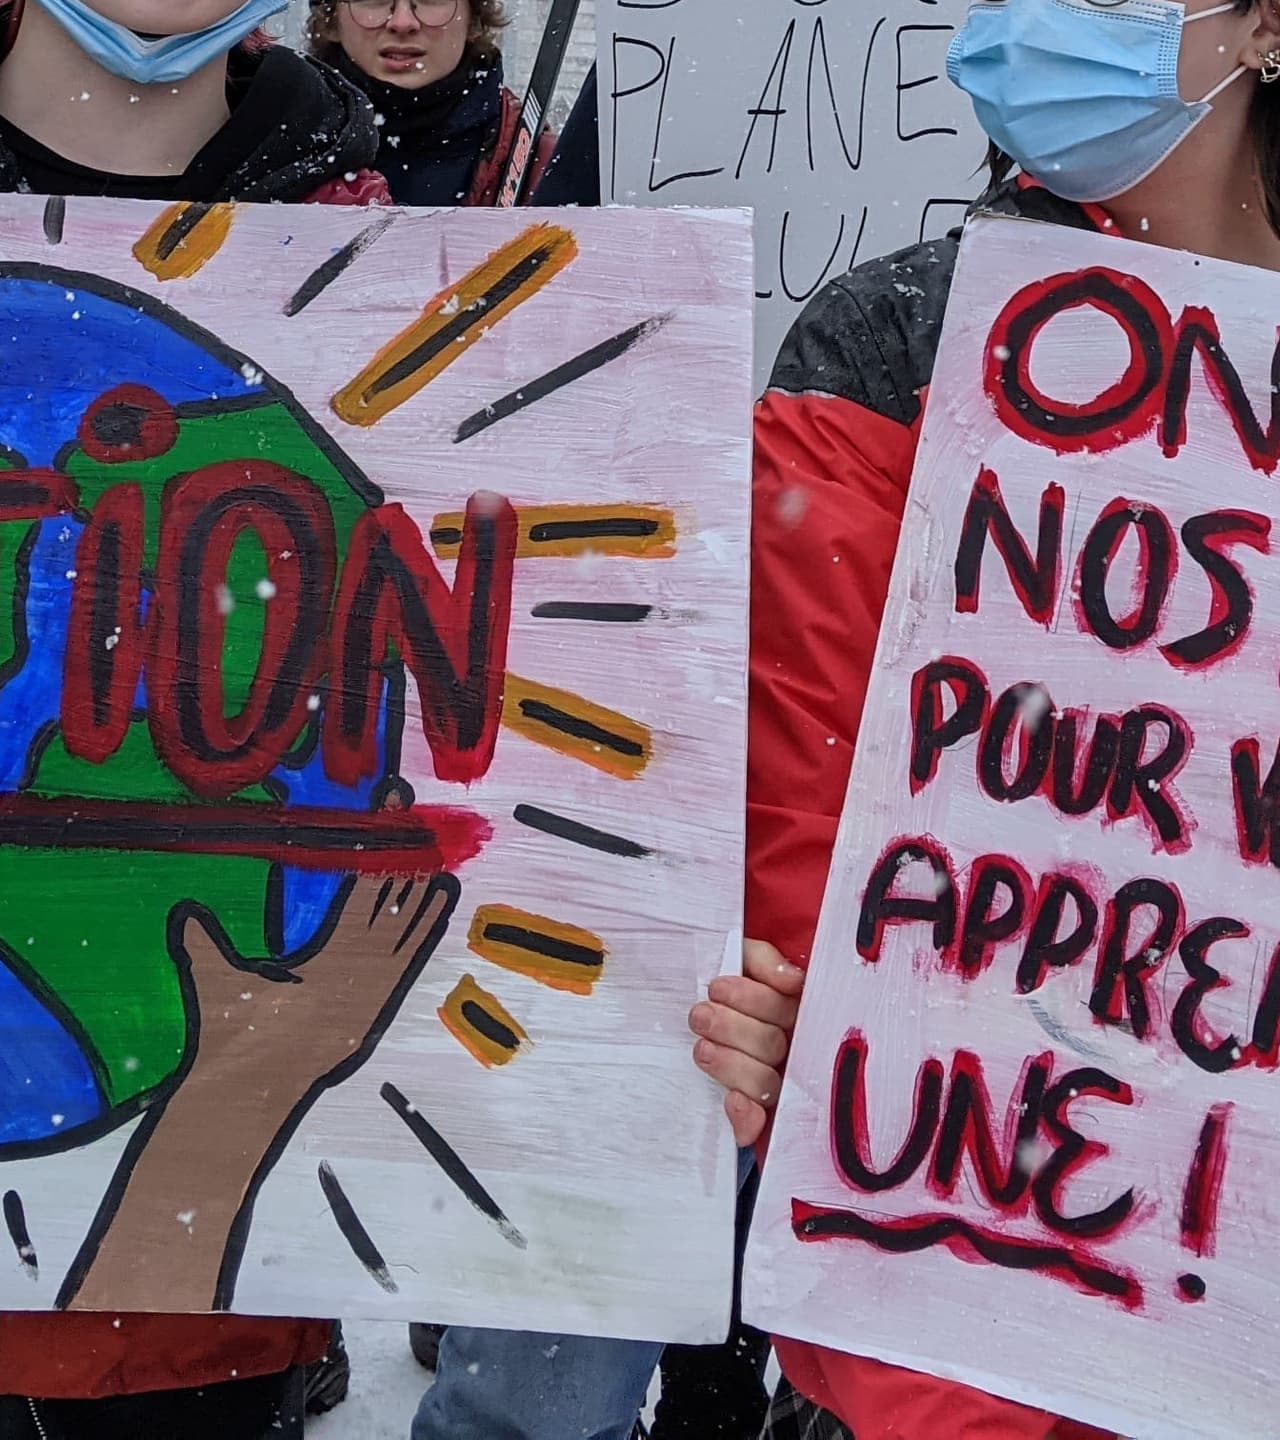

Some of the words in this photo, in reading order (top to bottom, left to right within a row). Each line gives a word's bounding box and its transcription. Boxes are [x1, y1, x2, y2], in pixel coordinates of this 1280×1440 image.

[954, 462, 1271, 671] NOS
[910, 657, 1197, 856] POUR
[830, 1026, 1136, 1239] UNE
